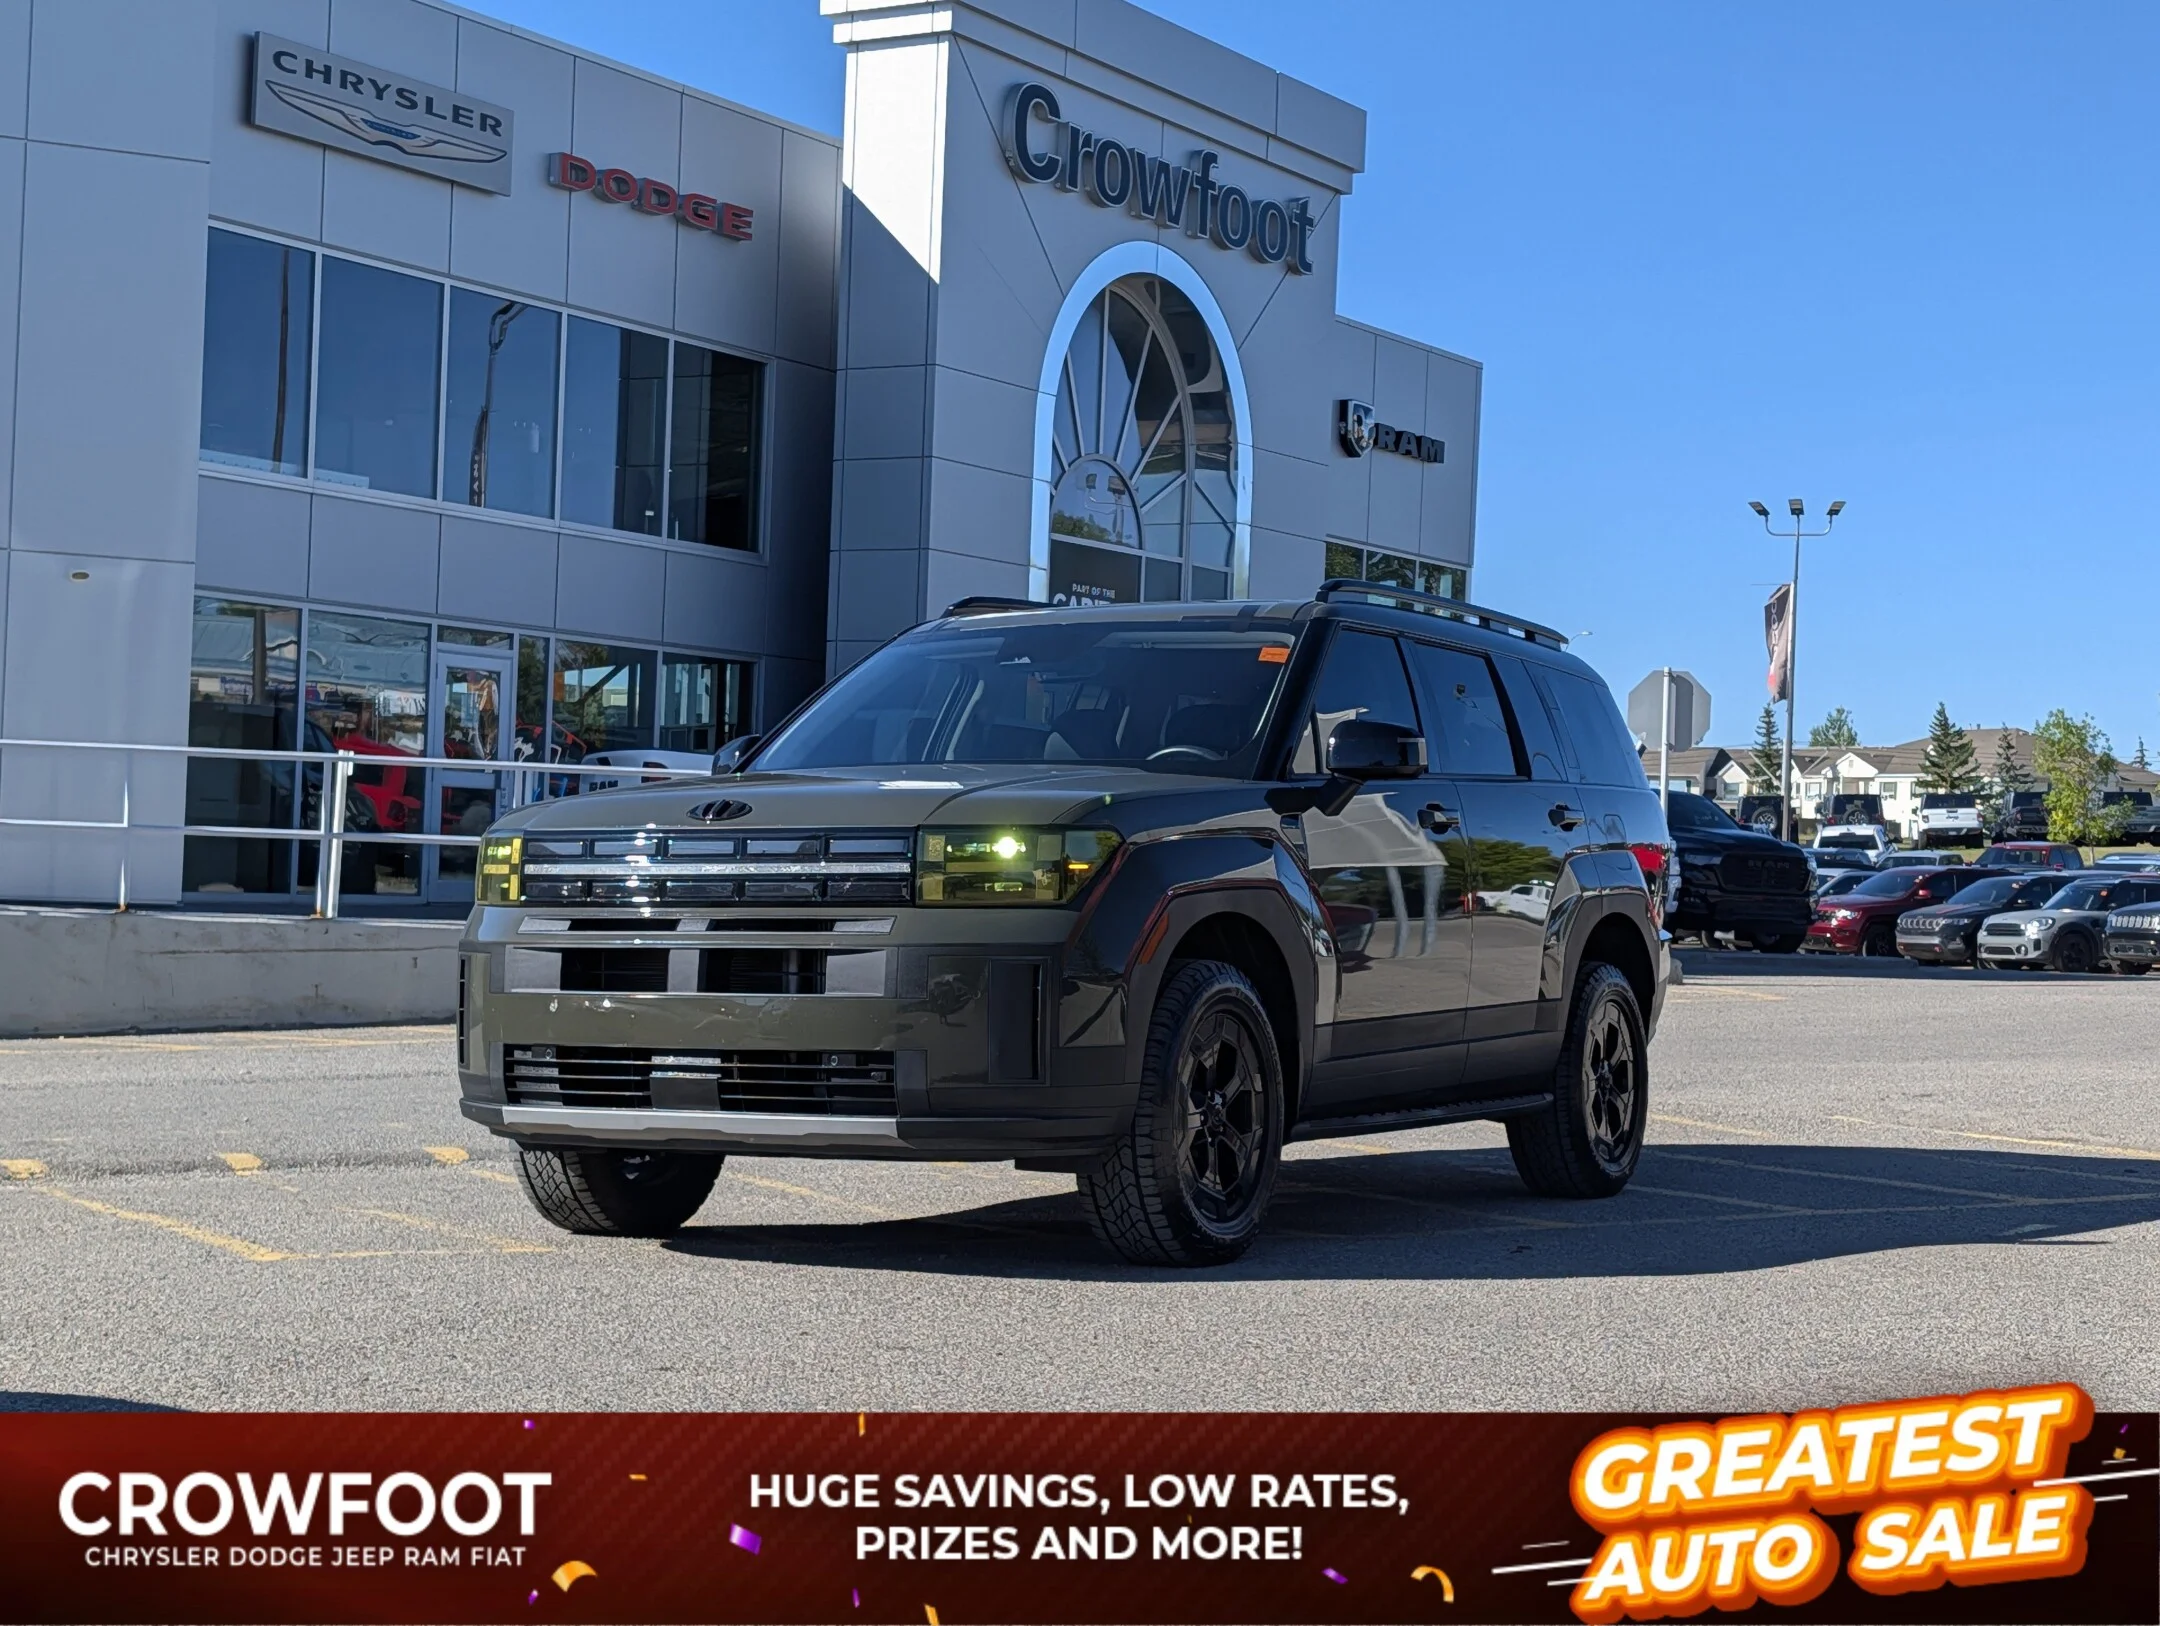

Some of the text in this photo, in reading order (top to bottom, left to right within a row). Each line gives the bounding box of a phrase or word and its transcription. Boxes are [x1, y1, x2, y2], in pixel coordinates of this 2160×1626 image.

[272, 49, 503, 137] CHRYSLER
[550, 151, 754, 241] DODGE
[1003, 81, 1315, 275] Crowfoot
[1374, 422, 1446, 464] RAM
